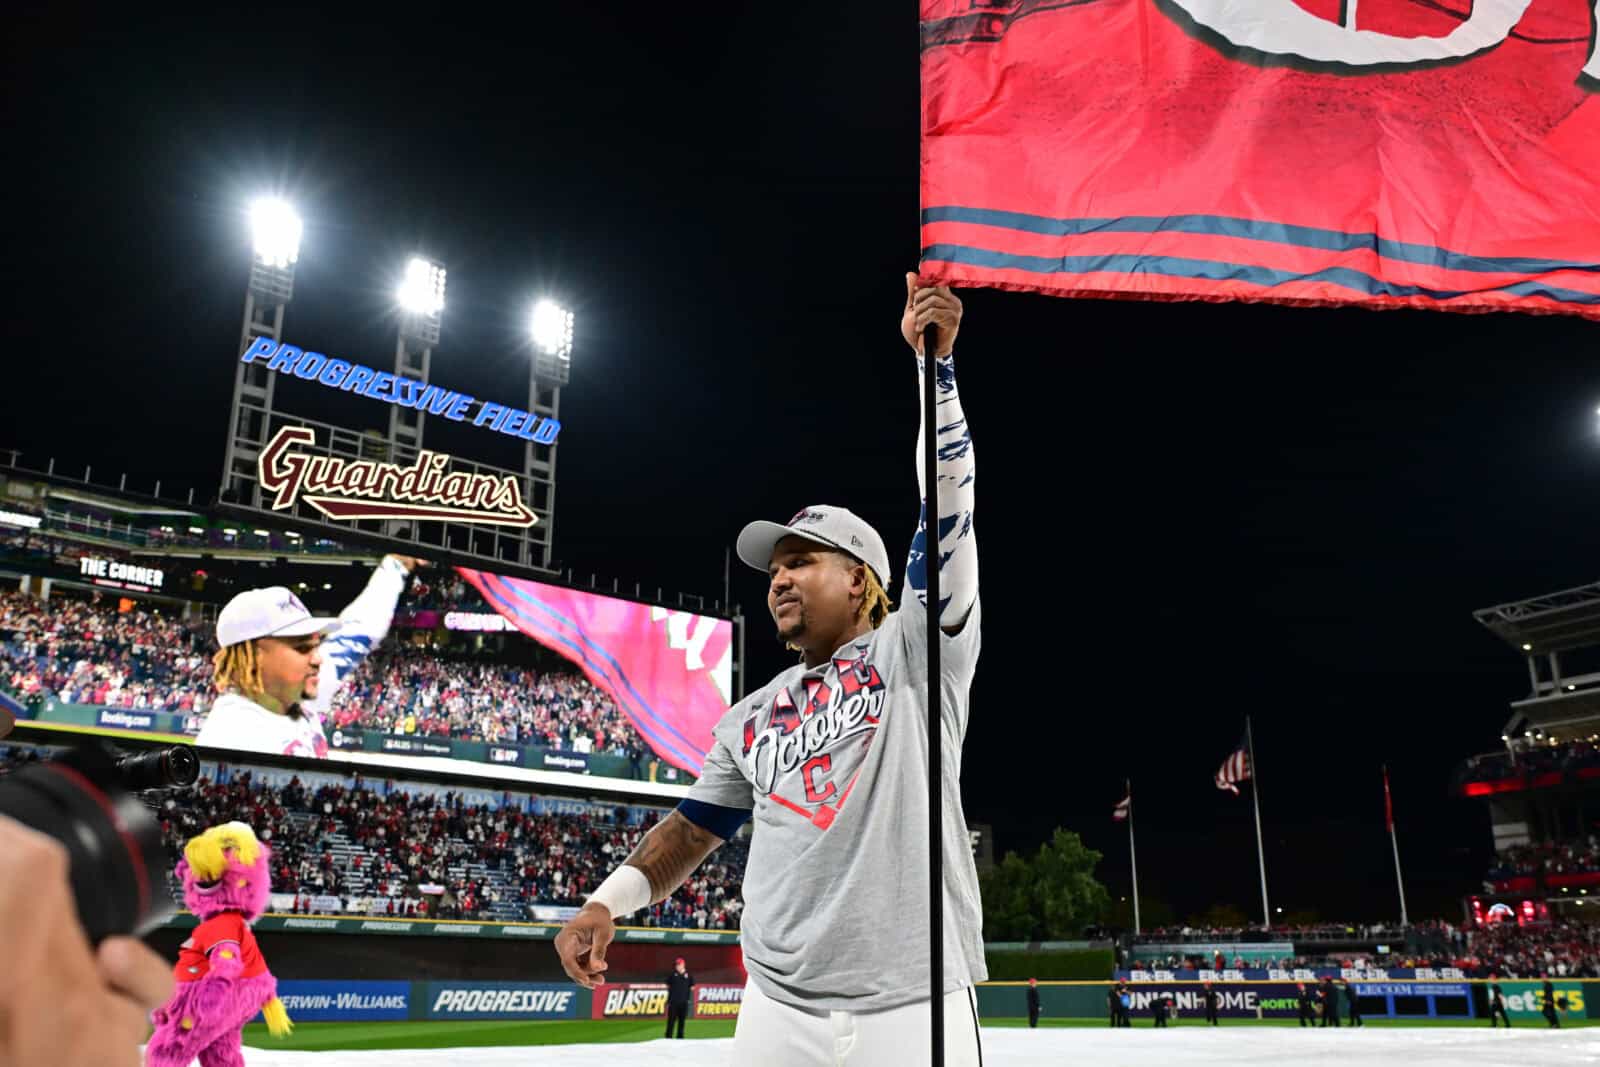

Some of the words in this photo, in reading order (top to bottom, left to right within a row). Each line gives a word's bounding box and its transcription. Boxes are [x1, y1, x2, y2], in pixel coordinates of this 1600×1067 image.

[242, 336, 476, 422] PROGRESSIVE
[474, 401, 562, 445] FIELD
[258, 425, 534, 512] Guardians
[80, 557, 107, 577] THE
[108, 562, 164, 587] CORNER
[750, 682, 886, 795] October
[800, 753, 837, 804] C
[433, 989, 574, 1013] PROGRESSIVE
[603, 989, 669, 1015] BLASTER
